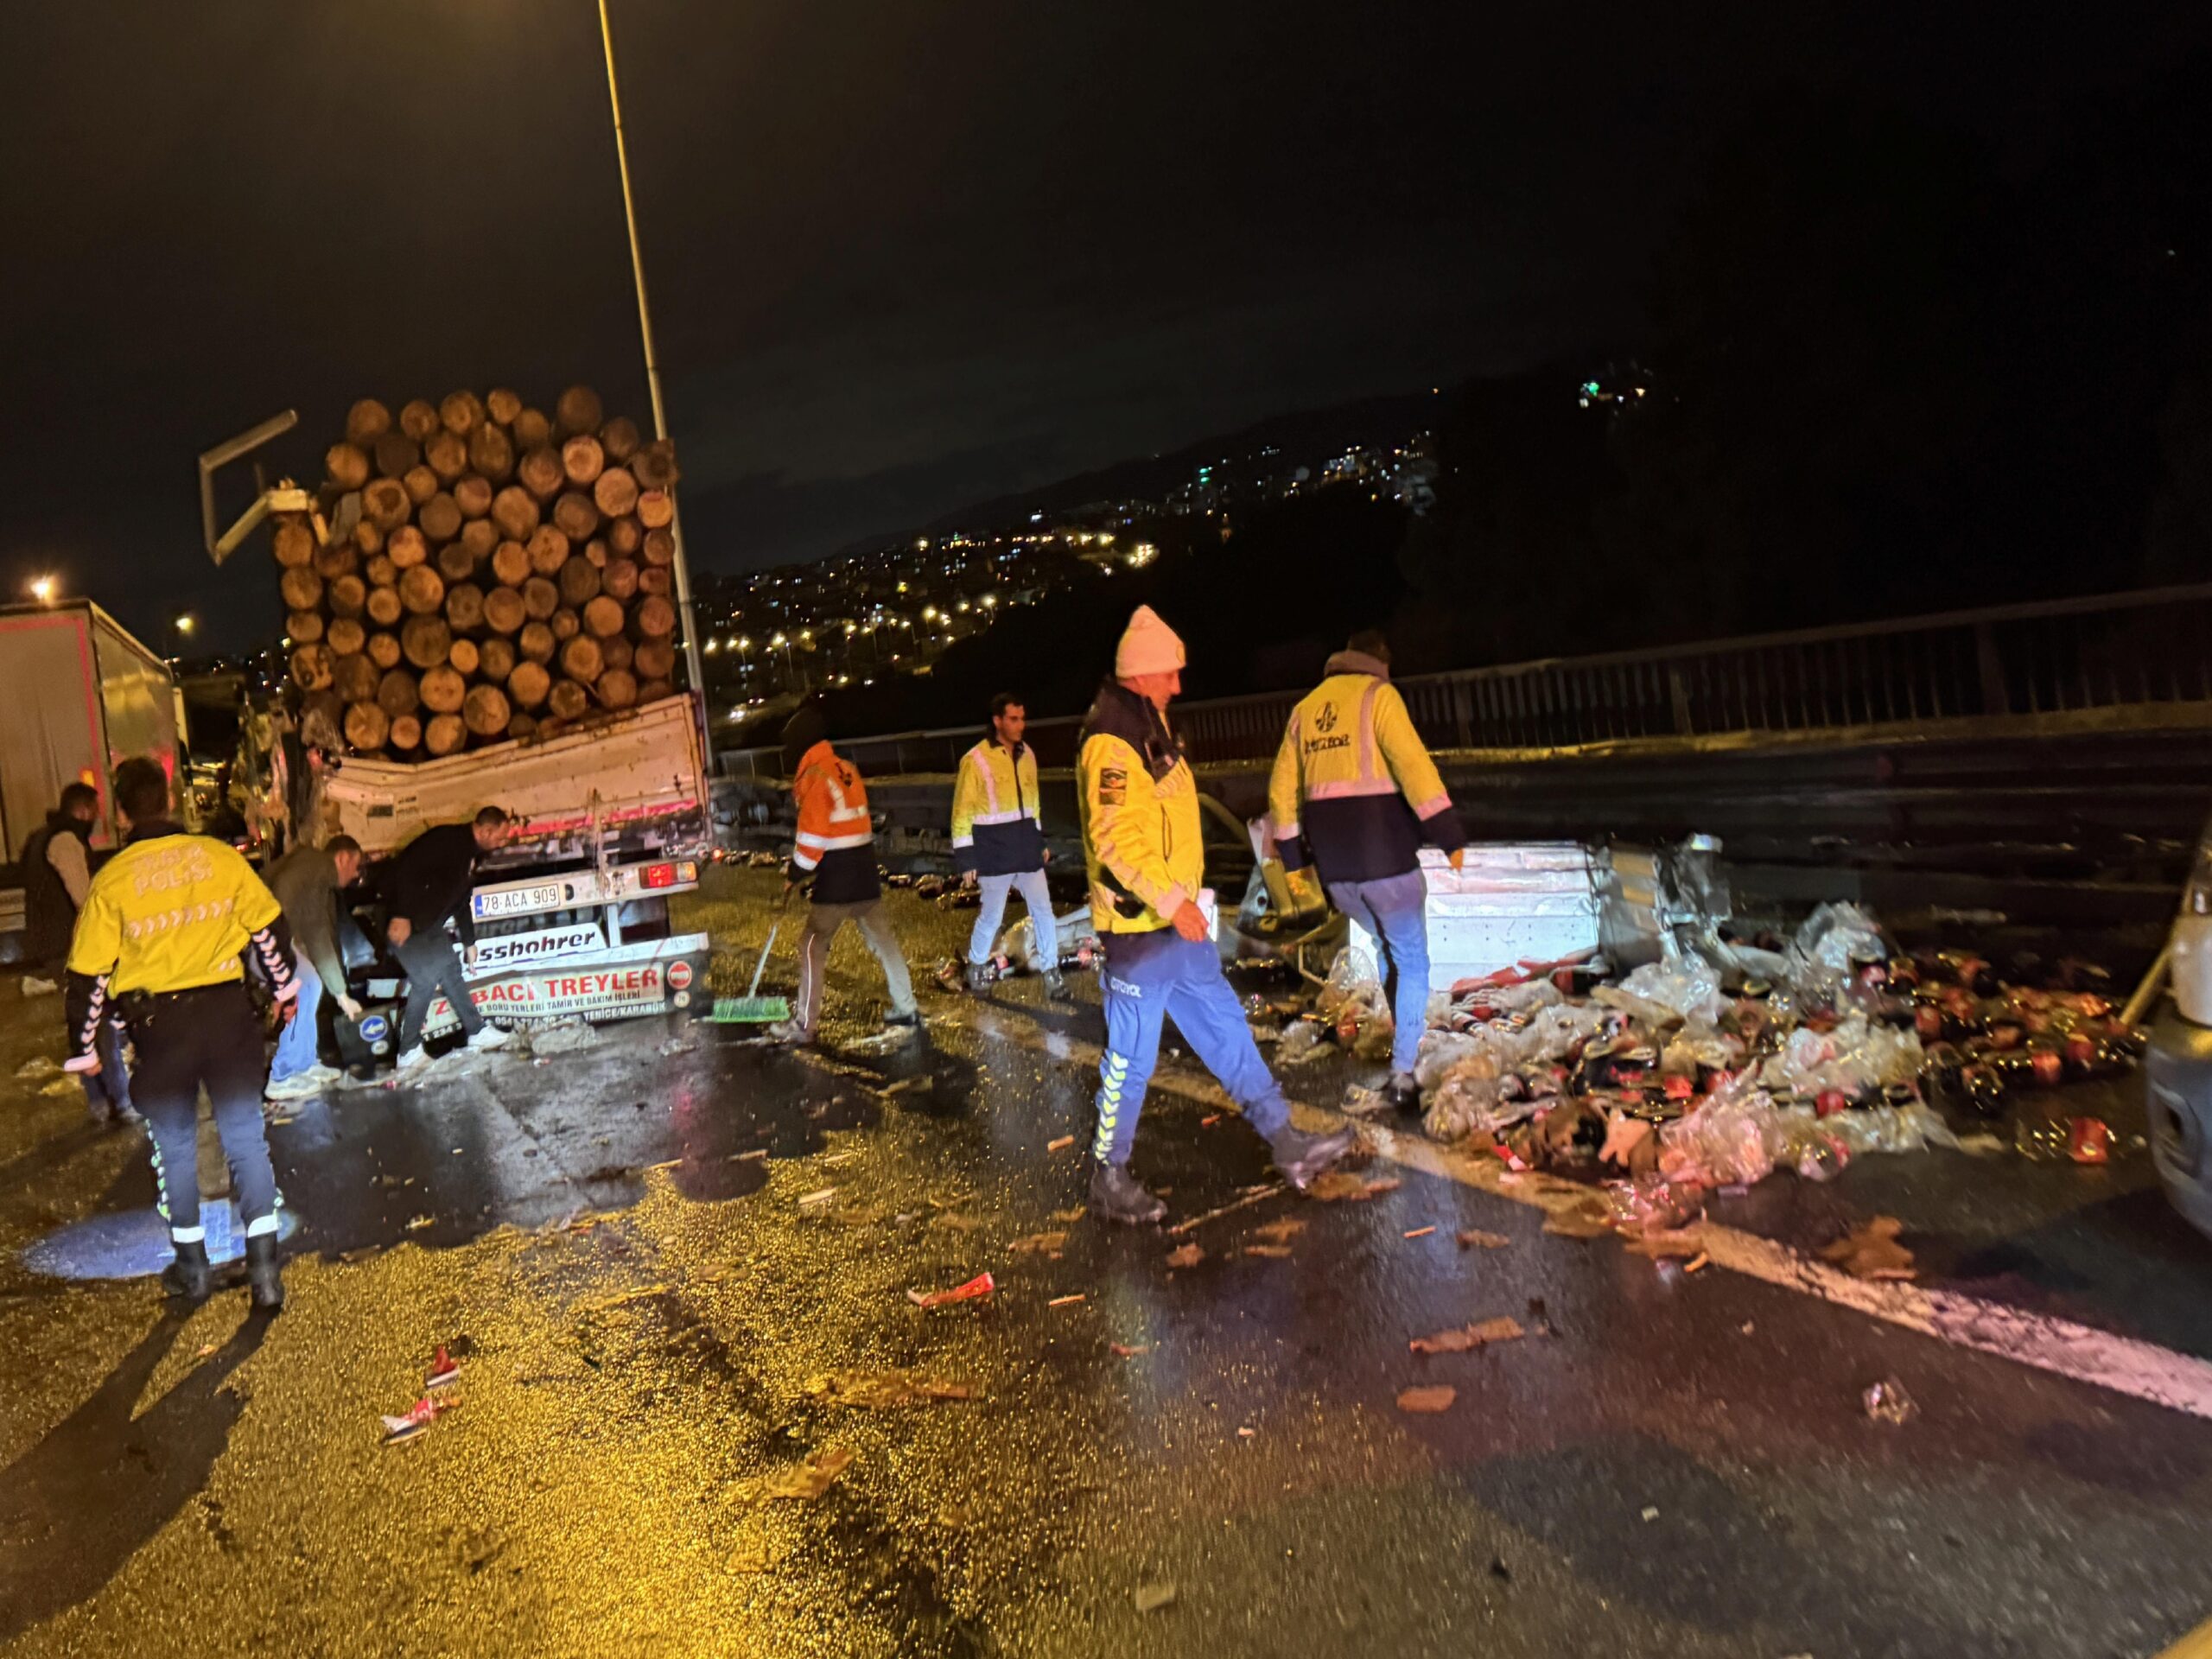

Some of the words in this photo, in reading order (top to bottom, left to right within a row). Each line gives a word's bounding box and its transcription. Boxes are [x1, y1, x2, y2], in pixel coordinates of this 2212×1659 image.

[484, 896, 499, 911] 78
[505, 892, 528, 908] ACA
[533, 887, 556, 904] 909
[545, 969, 658, 998] TREYLER
[575, 996, 584, 1006] VE
